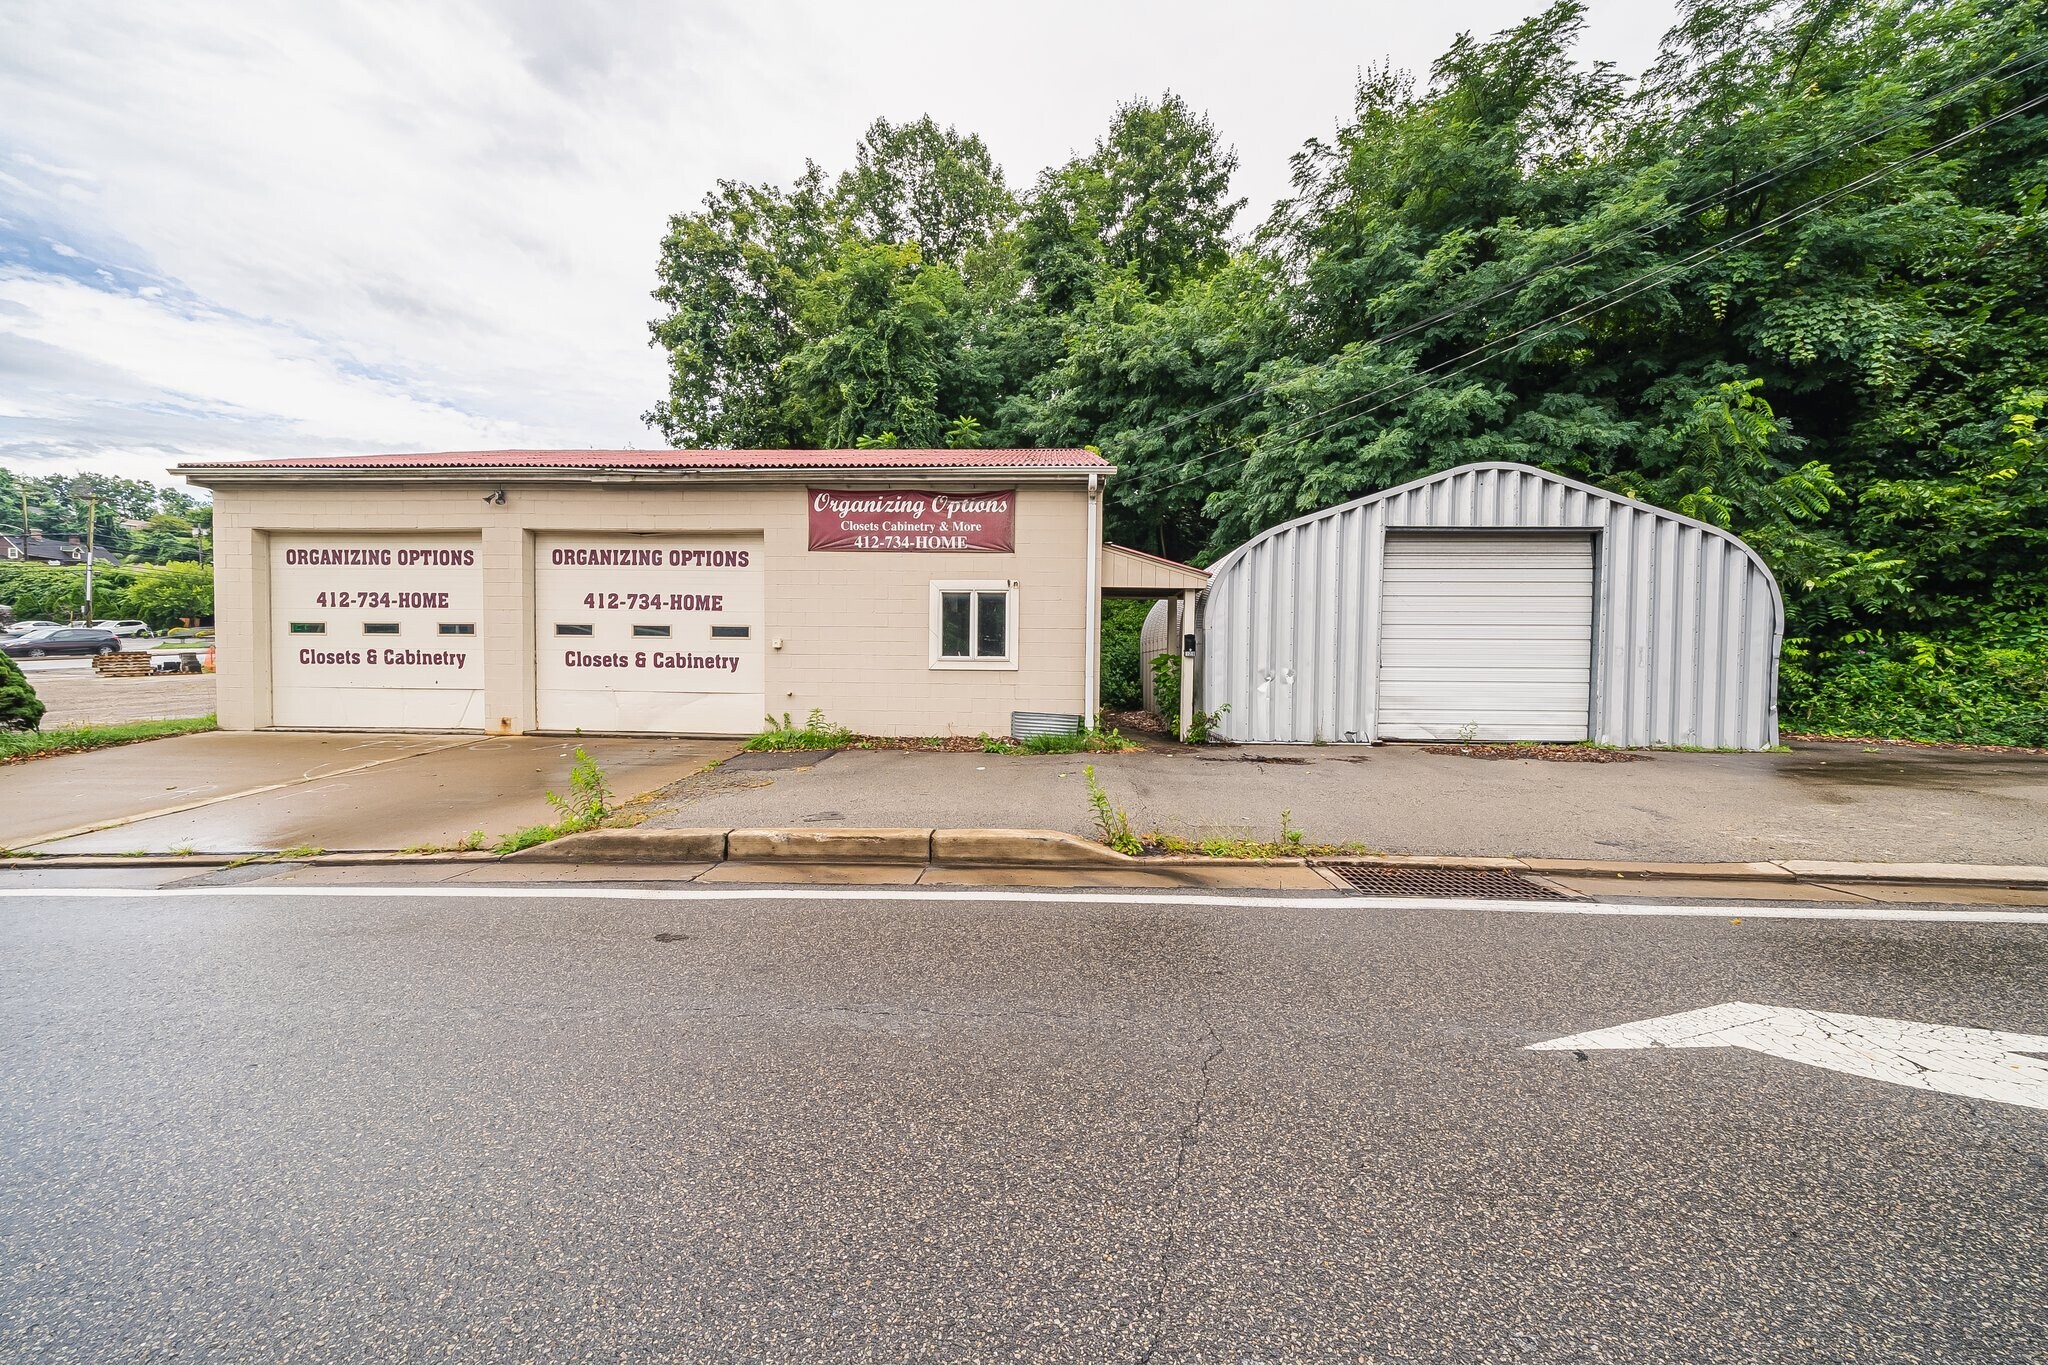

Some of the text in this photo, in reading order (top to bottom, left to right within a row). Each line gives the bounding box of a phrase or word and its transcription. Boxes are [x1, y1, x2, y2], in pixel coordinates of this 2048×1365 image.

[814, 493, 1008, 519] Organizing Options
[840, 520, 982, 533] Closets Cabinetry & More
[854, 535, 968, 549] 412-734-HOME
[286, 549, 475, 566] ORGANIZING OPTIONS
[552, 549, 750, 567] ORGANIZING OPTIONS
[316, 591, 449, 609] 412-734-HOME
[584, 593, 723, 611] 412-734-HOME
[299, 648, 467, 670] Closets & Cabinetry
[565, 650, 740, 673] Closets & Cabinetry
